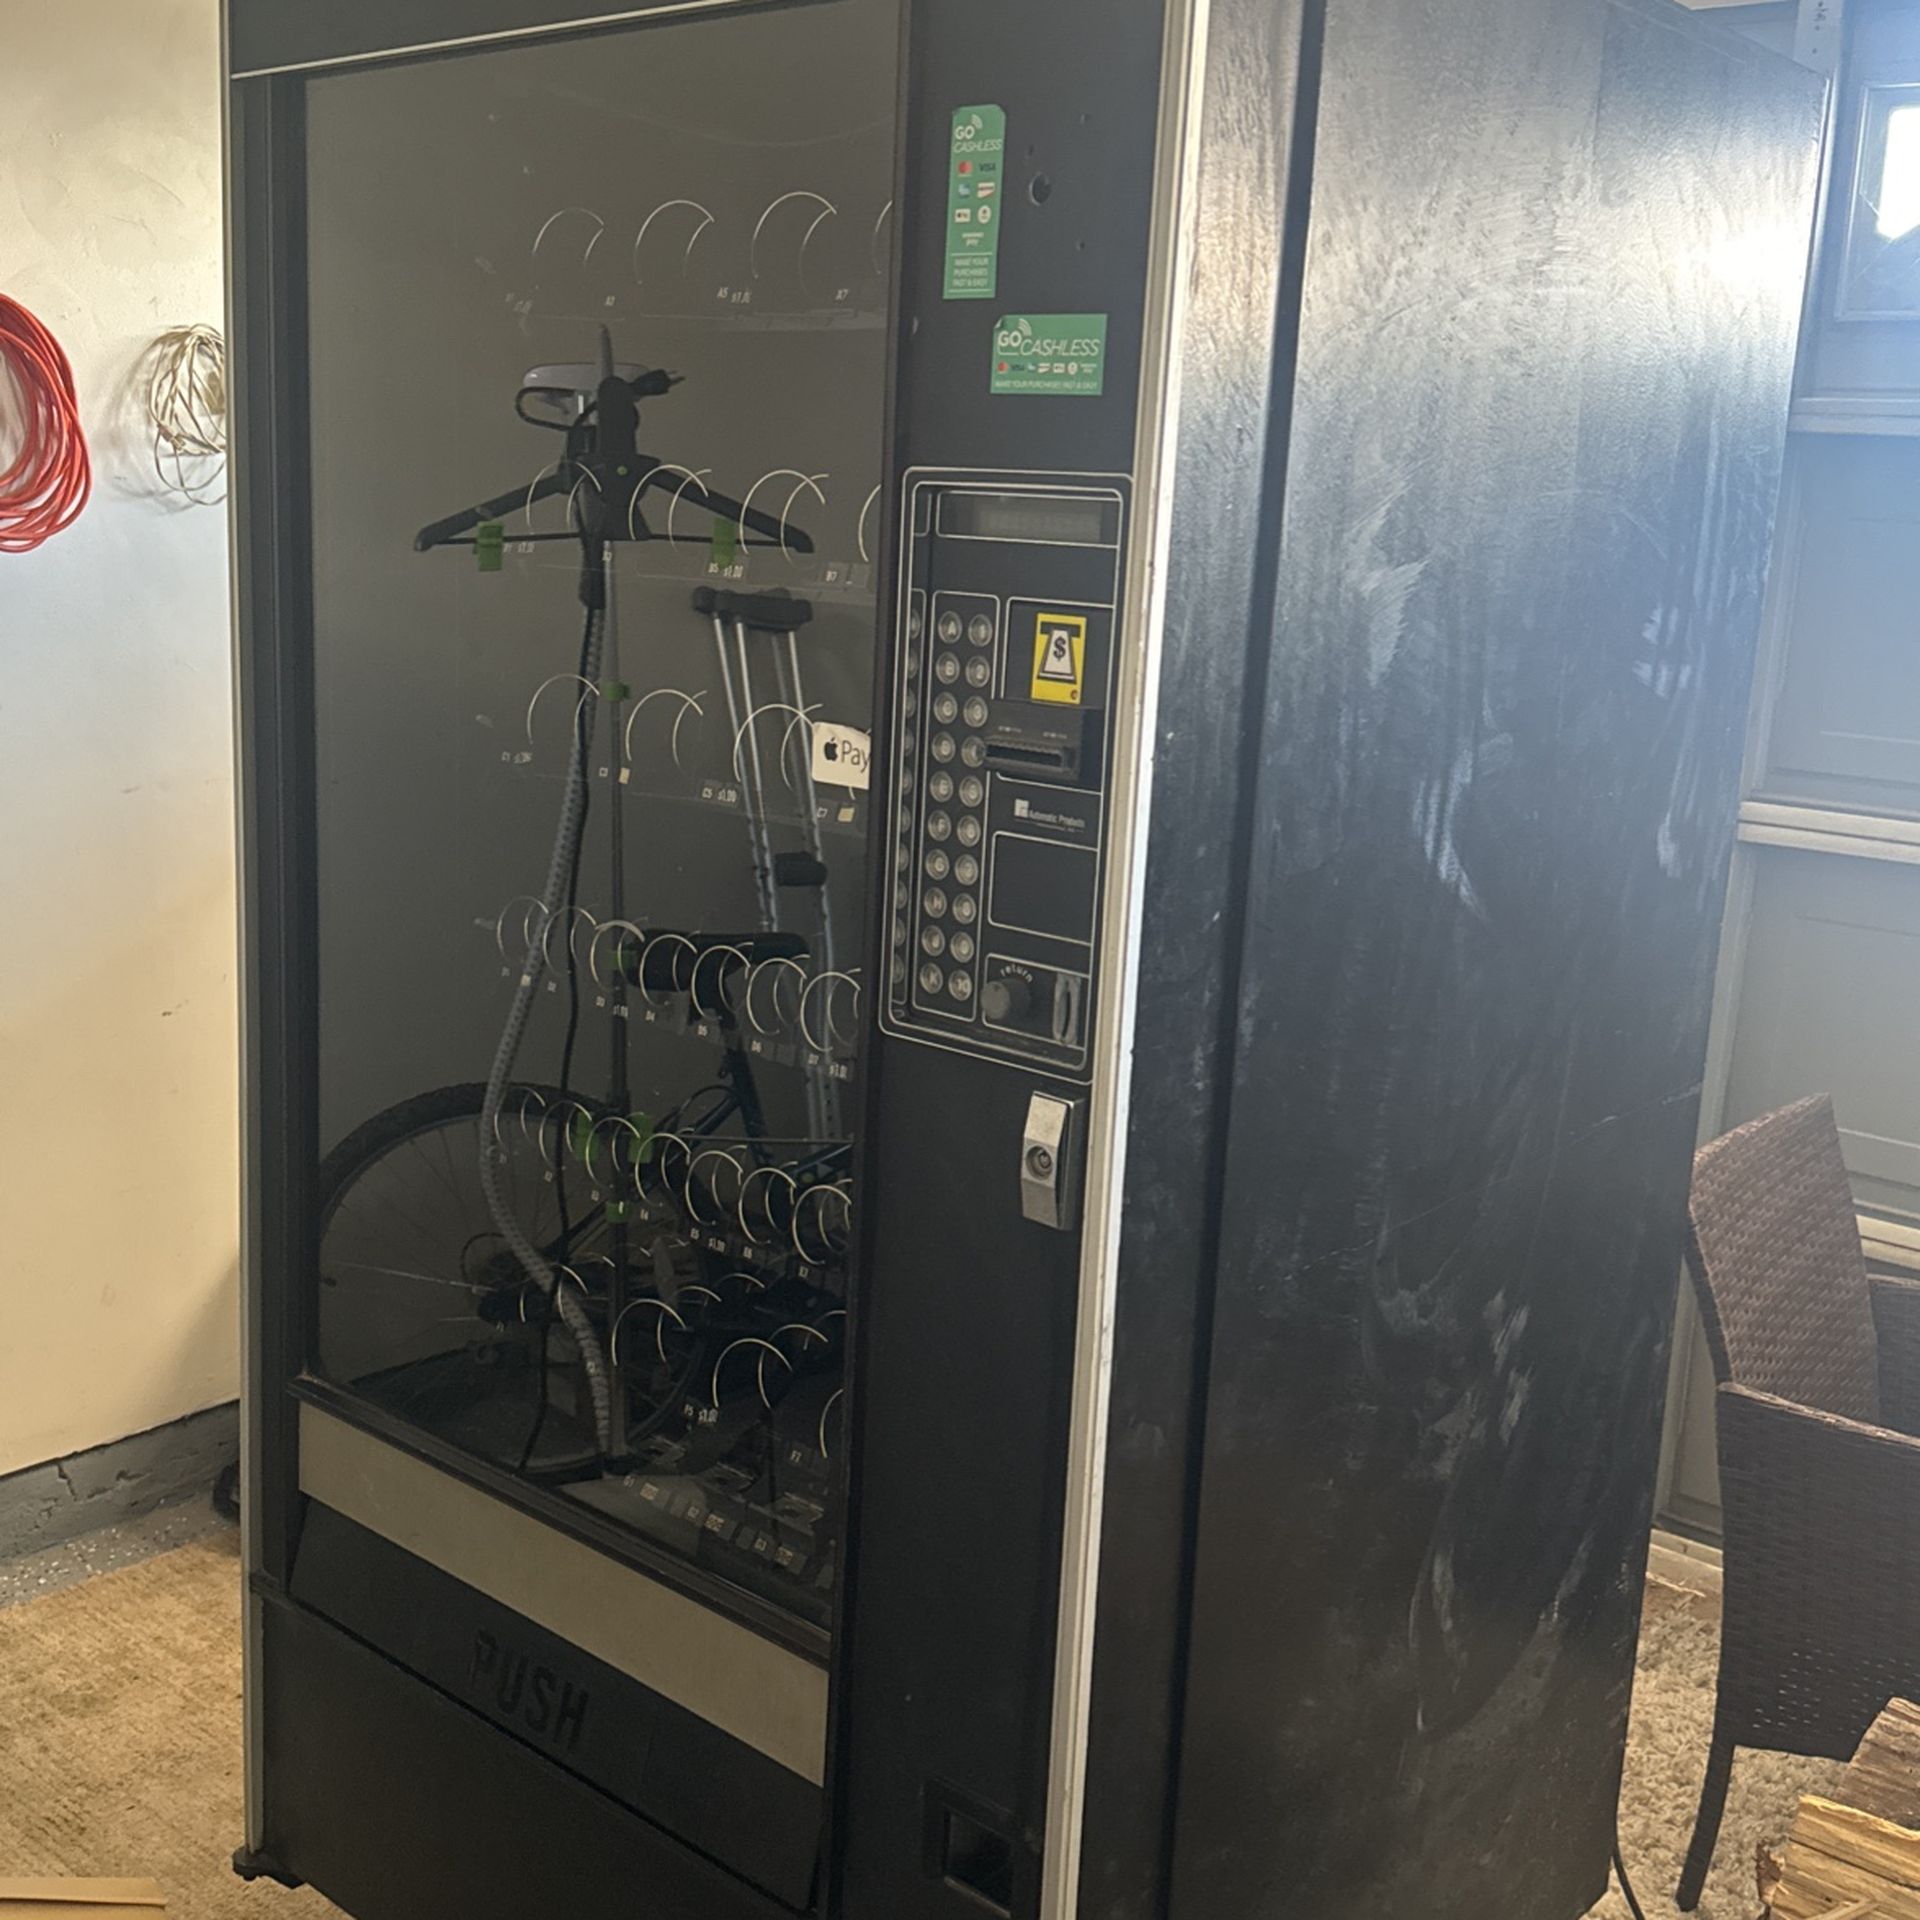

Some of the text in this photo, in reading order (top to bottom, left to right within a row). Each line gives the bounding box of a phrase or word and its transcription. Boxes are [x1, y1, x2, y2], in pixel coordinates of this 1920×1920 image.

[955, 125, 975, 140] GO
[954, 139, 1002, 153] CASHLESS
[998, 330, 1022, 348] GO
[1020, 338, 1101, 356] CASHLESS
[841, 739, 871, 773] Pay
[1000, 963, 1033, 983] return
[467, 1629, 588, 1750] PUSH
